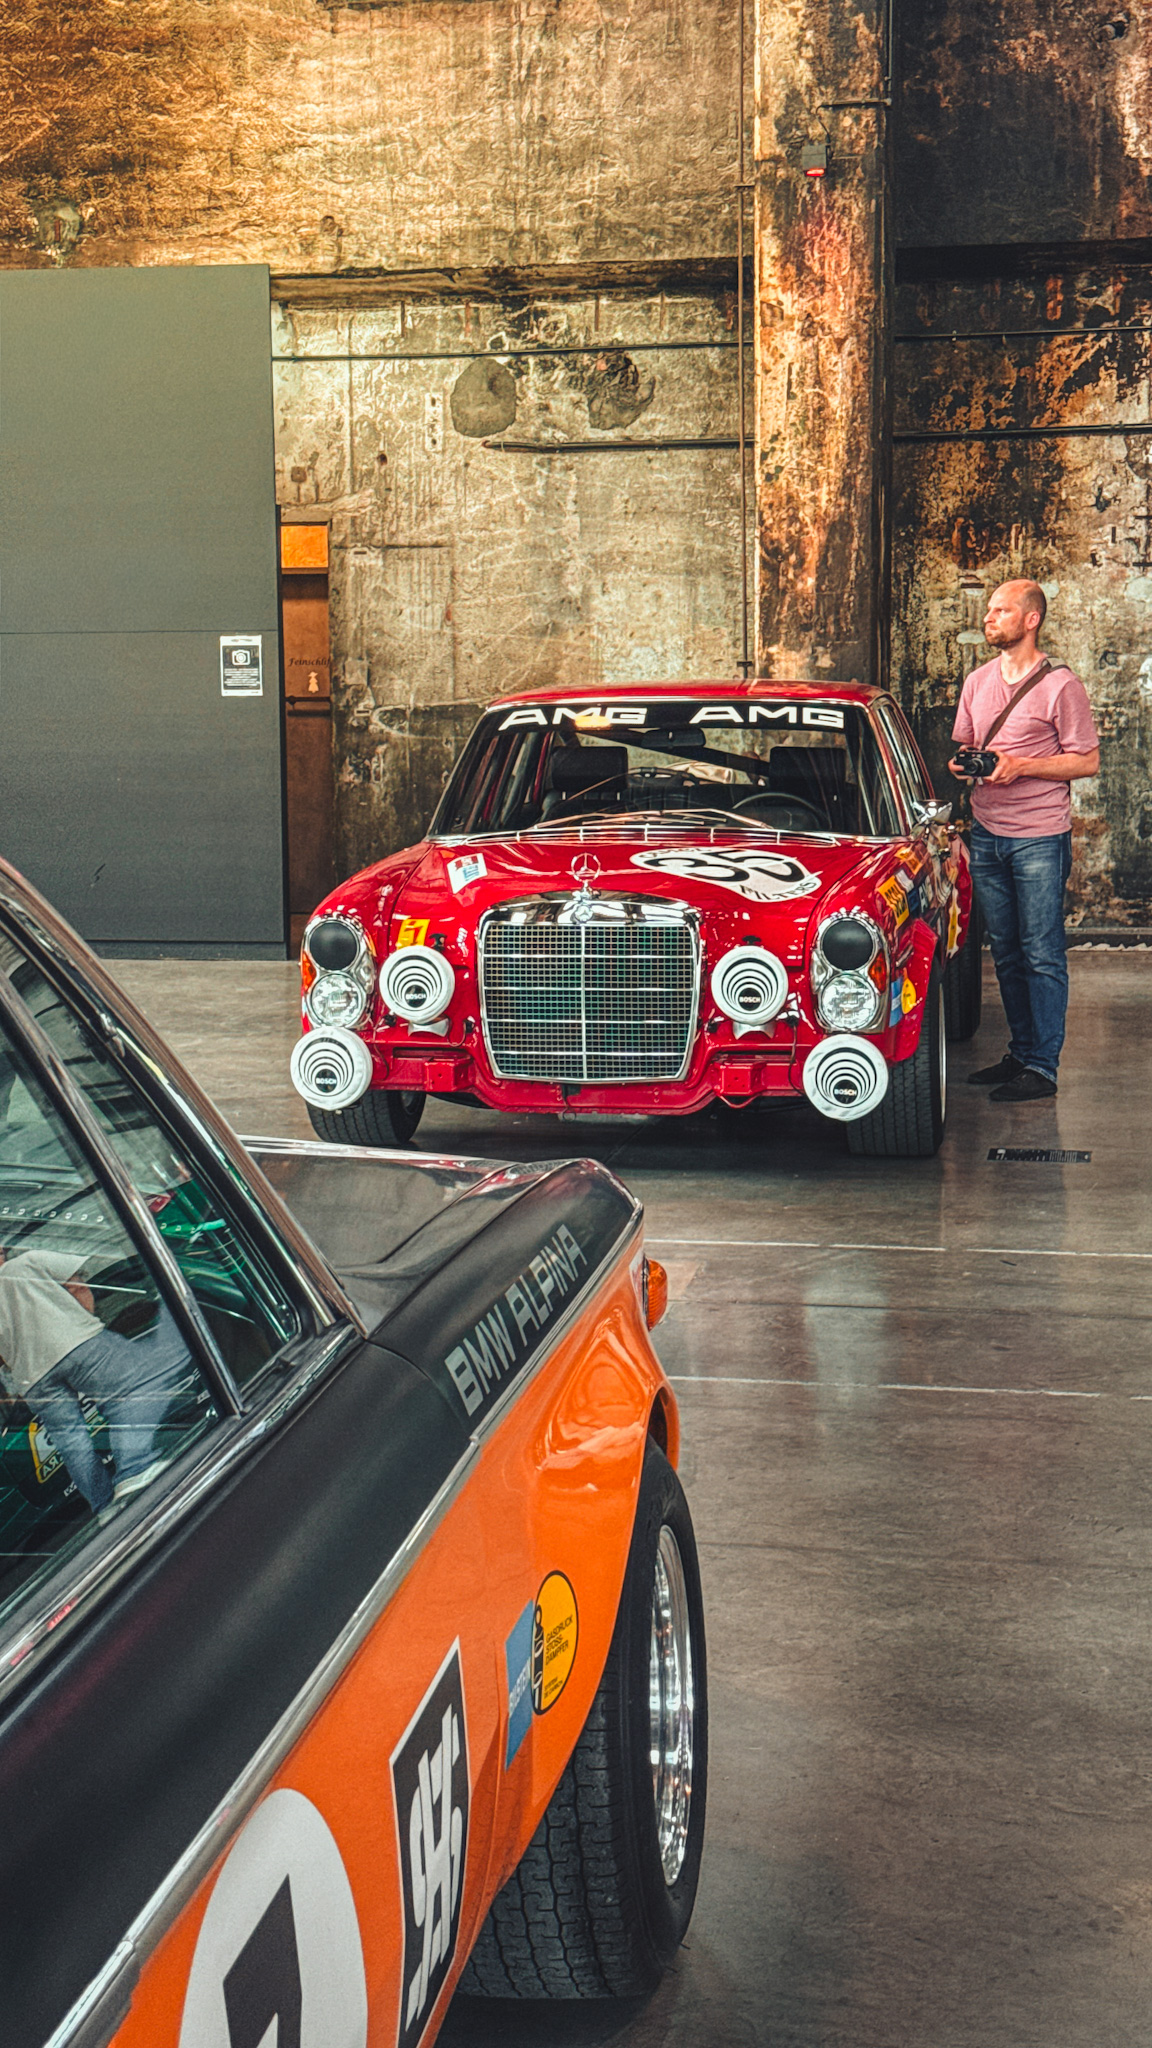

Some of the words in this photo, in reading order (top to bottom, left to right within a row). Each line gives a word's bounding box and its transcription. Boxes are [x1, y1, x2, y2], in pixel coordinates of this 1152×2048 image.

[498, 707, 648, 731] AMG
[689, 706, 844, 729] AMG
[643, 850, 805, 883] 35
[740, 881, 817, 901] FILTERS
[834, 1088, 857, 1096] BOSCH
[444, 1304, 517, 1417] BMW
[505, 1224, 588, 1347] ALPINA
[546, 1614, 574, 1643] GASDRUCK
